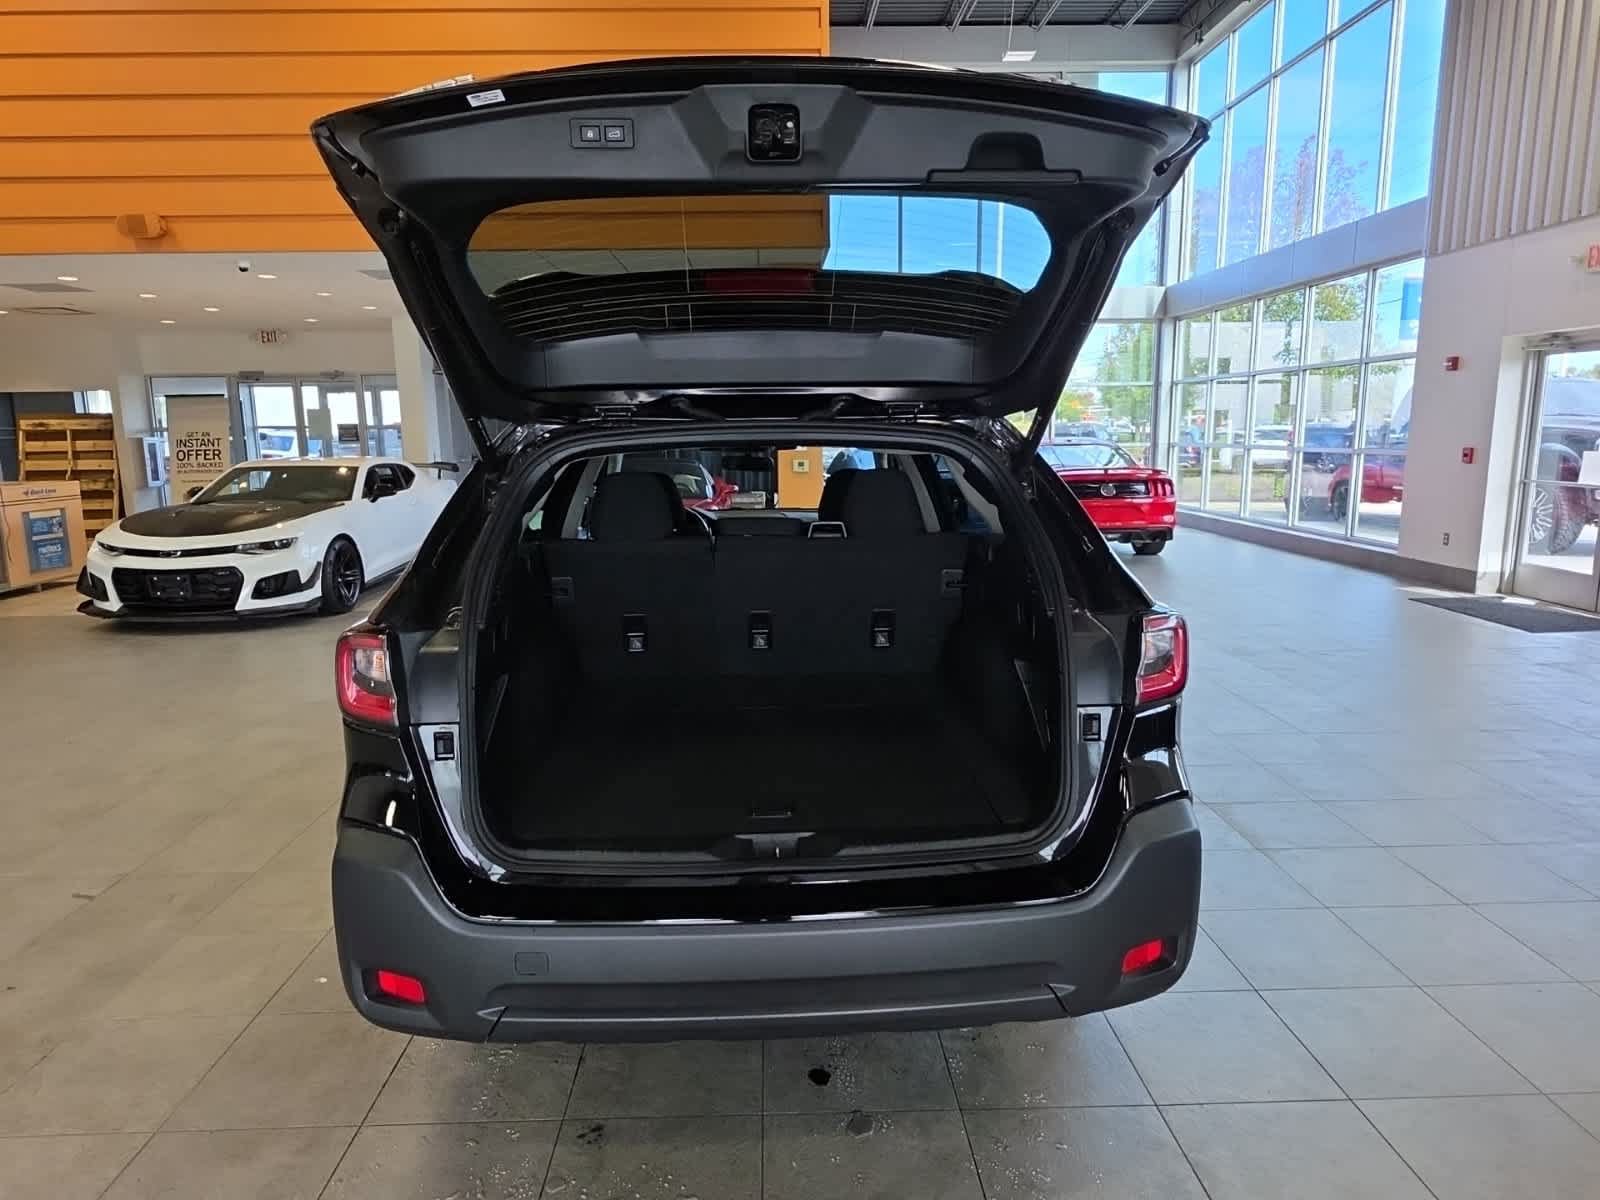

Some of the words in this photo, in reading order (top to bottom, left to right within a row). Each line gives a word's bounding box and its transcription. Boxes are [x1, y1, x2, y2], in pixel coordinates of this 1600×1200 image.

[261, 330, 278, 343] EXIT
[176, 438, 222, 448] INSTANT
[176, 449, 222, 461] OFFER
